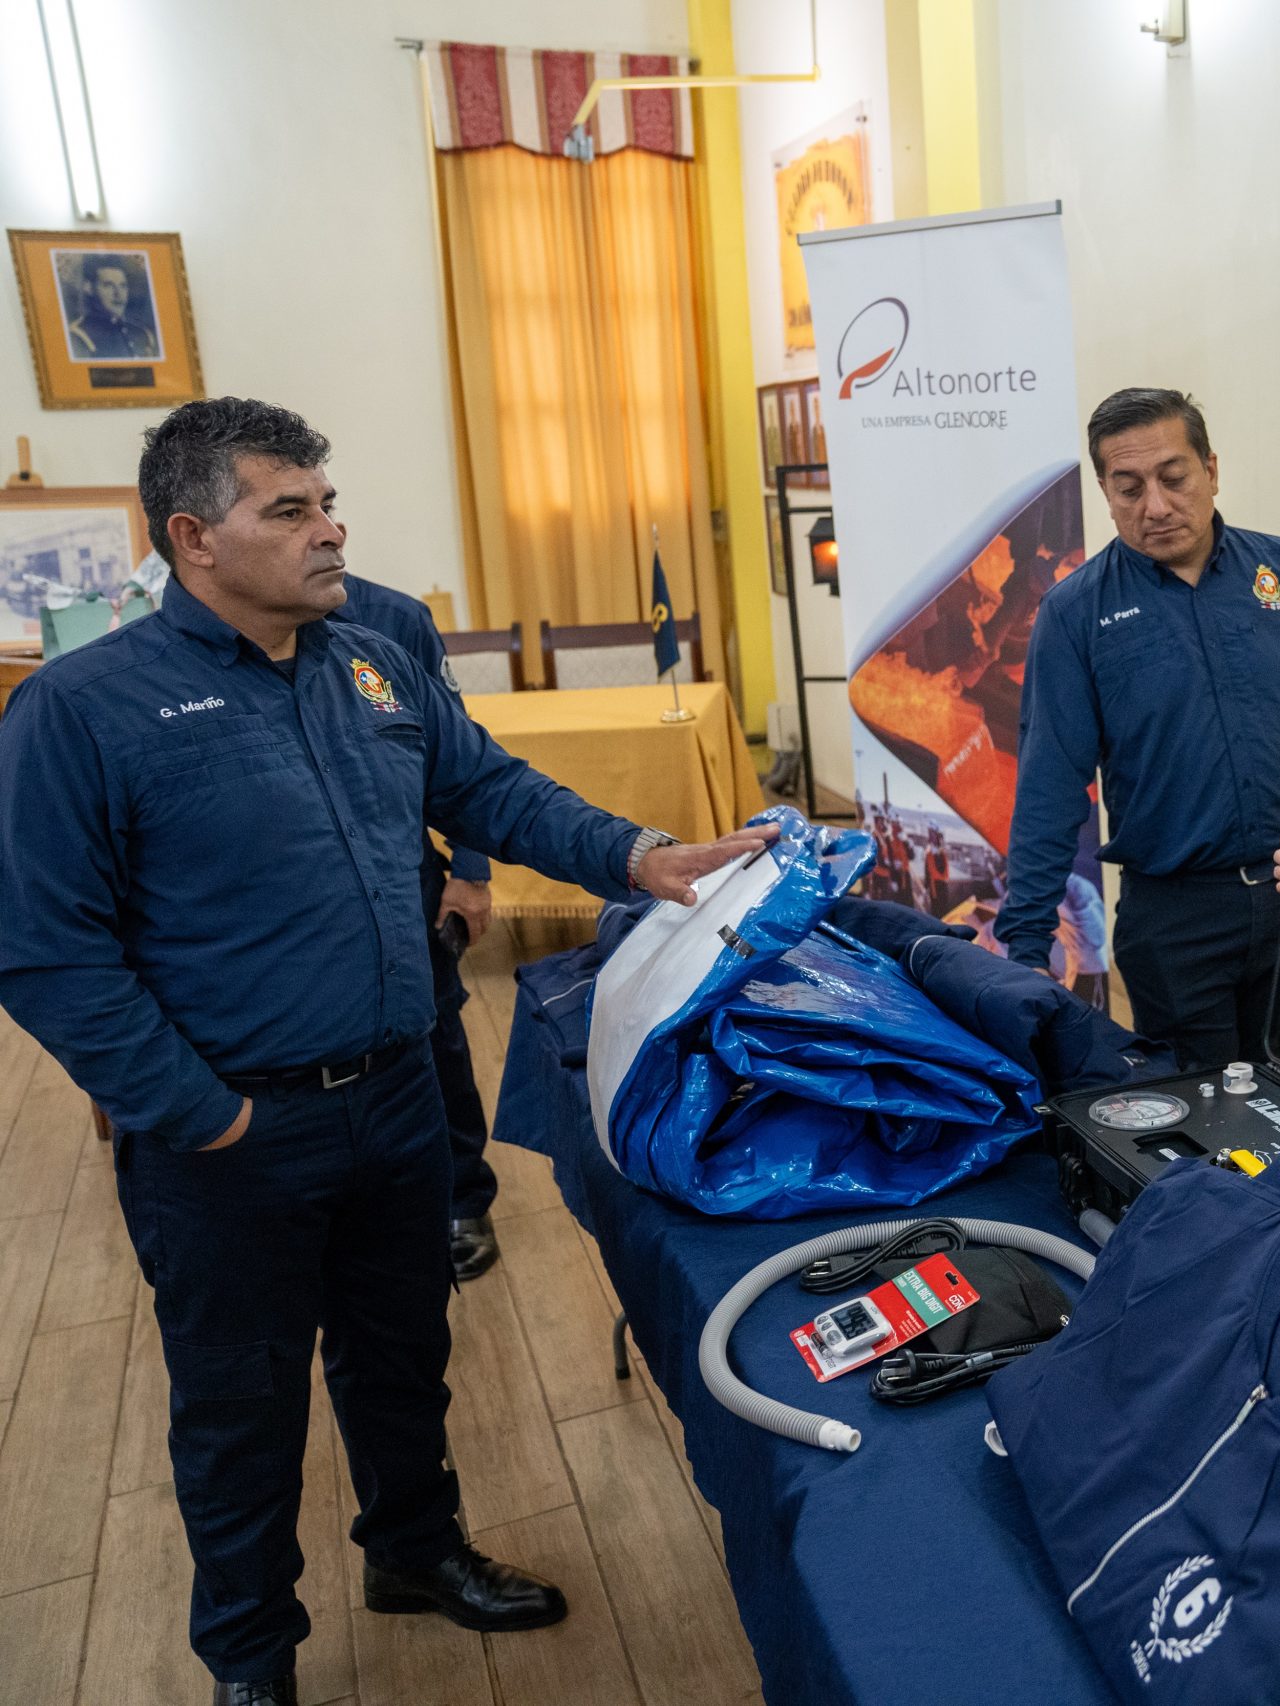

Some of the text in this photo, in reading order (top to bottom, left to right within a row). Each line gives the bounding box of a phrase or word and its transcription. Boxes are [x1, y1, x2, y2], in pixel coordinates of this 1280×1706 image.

[893, 366, 1037, 397] Altonorte
[862, 410, 1008, 430] UNA EMPRESA GLENCORE
[160, 696, 225, 717] G. Mariño
[904, 1270, 923, 1291] EXTRA
[917, 1287, 932, 1301] BIG
[925, 1297, 943, 1314] DIGIT
[949, 1294, 965, 1310] CDN
[1173, 1577, 1222, 1628] 6
